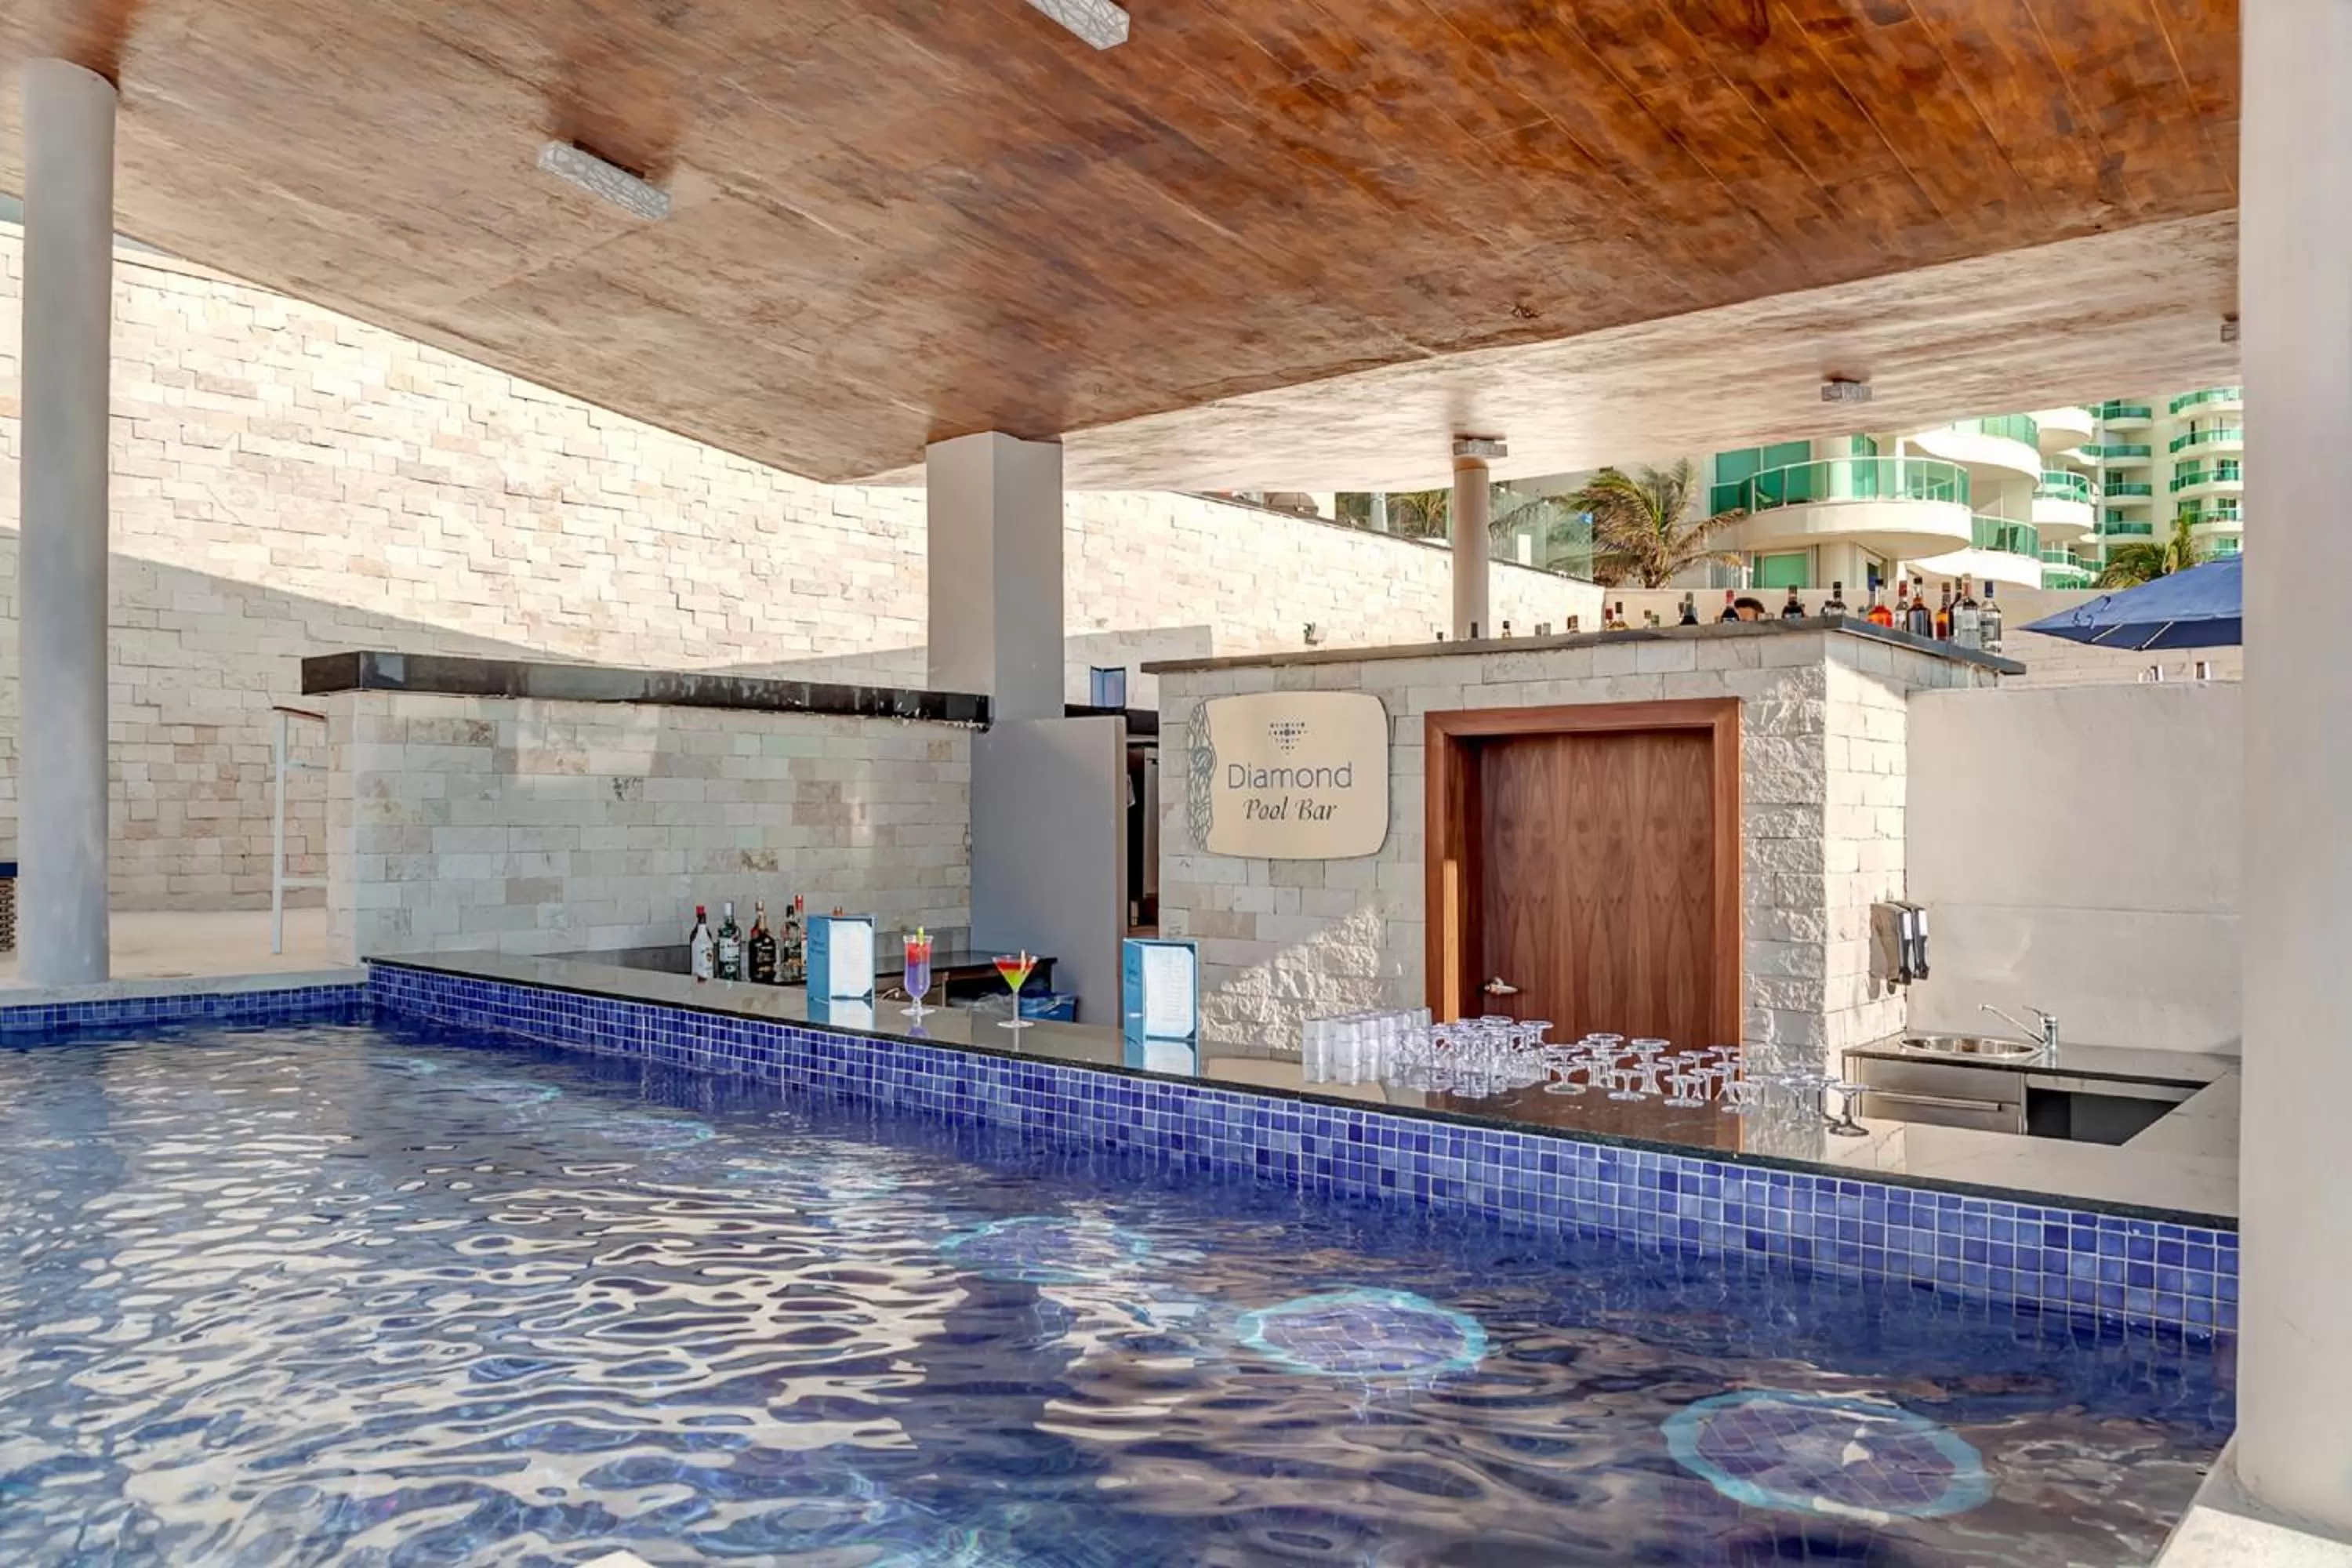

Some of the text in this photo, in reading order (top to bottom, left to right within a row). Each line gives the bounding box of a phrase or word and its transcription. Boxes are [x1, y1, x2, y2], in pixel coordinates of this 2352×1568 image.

[1228, 762, 1352, 789] Diamond
[1243, 796, 1338, 821] Pool Bar
